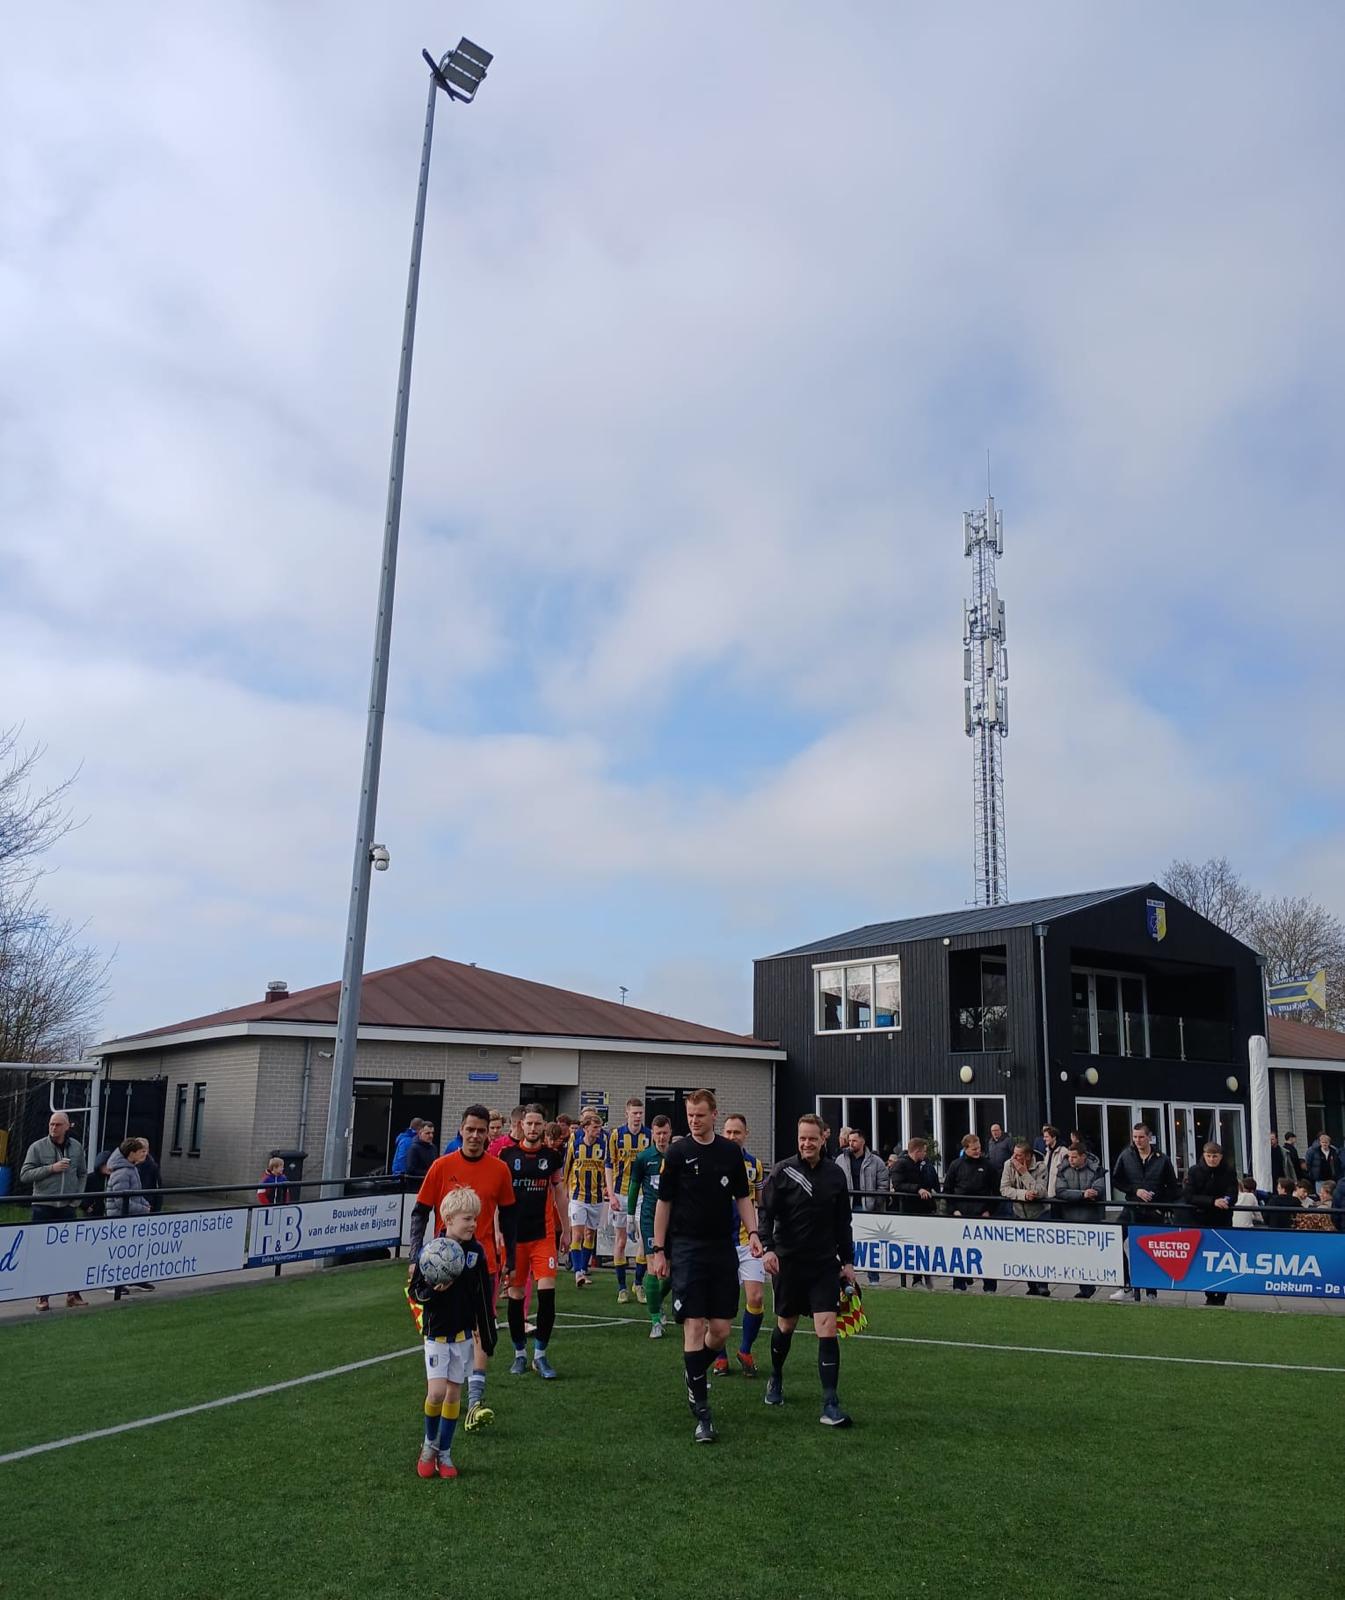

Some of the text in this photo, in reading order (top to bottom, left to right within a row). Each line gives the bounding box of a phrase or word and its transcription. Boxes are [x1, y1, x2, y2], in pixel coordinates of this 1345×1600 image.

[514, 1158, 521, 1171] 8
[332, 1204, 378, 1219] Bouwbedrijf
[46, 1213, 234, 1246] Dé Fryske reisorganisatie
[308, 1217, 398, 1237] van der Haak en Bijlstra
[108, 1238, 184, 1260] voor jouw
[1148, 1240, 1191, 1251] ELECTRO
[1152, 1249, 1188, 1259] WORLD
[548, 1256, 555, 1269] 8
[853, 1239, 983, 1275] WEIDENAAR
[1202, 1251, 1322, 1278] TALSMA
[86, 1256, 197, 1285] Elfstedentocht
[1265, 1280, 1313, 1293] Dokkum
[1325, 1283, 1340, 1294] De
